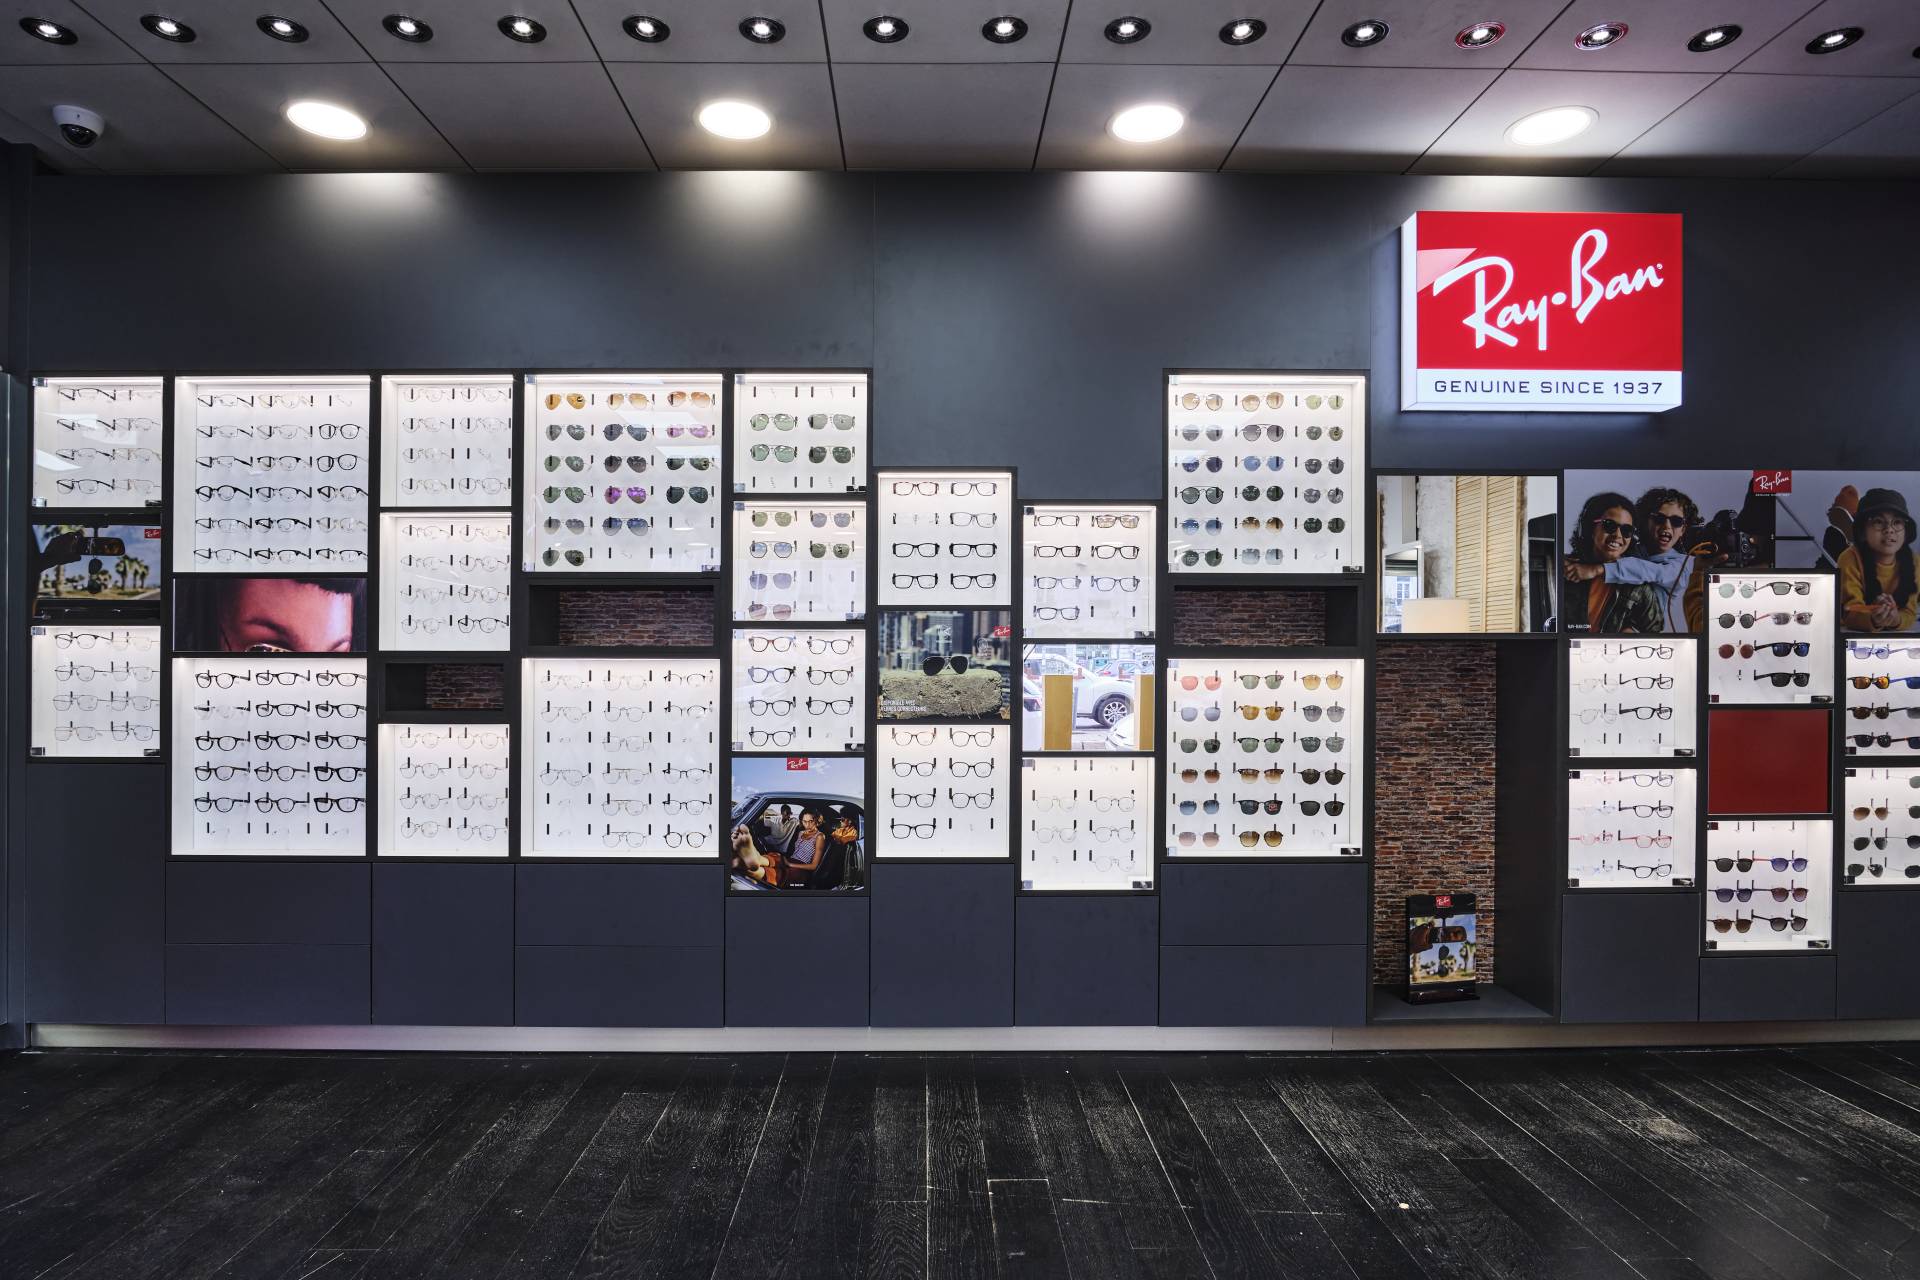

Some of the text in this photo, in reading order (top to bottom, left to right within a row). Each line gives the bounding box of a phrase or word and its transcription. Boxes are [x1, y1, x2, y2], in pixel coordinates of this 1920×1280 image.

[1434, 380, 1663, 394] GENUINE SINCE 1937
